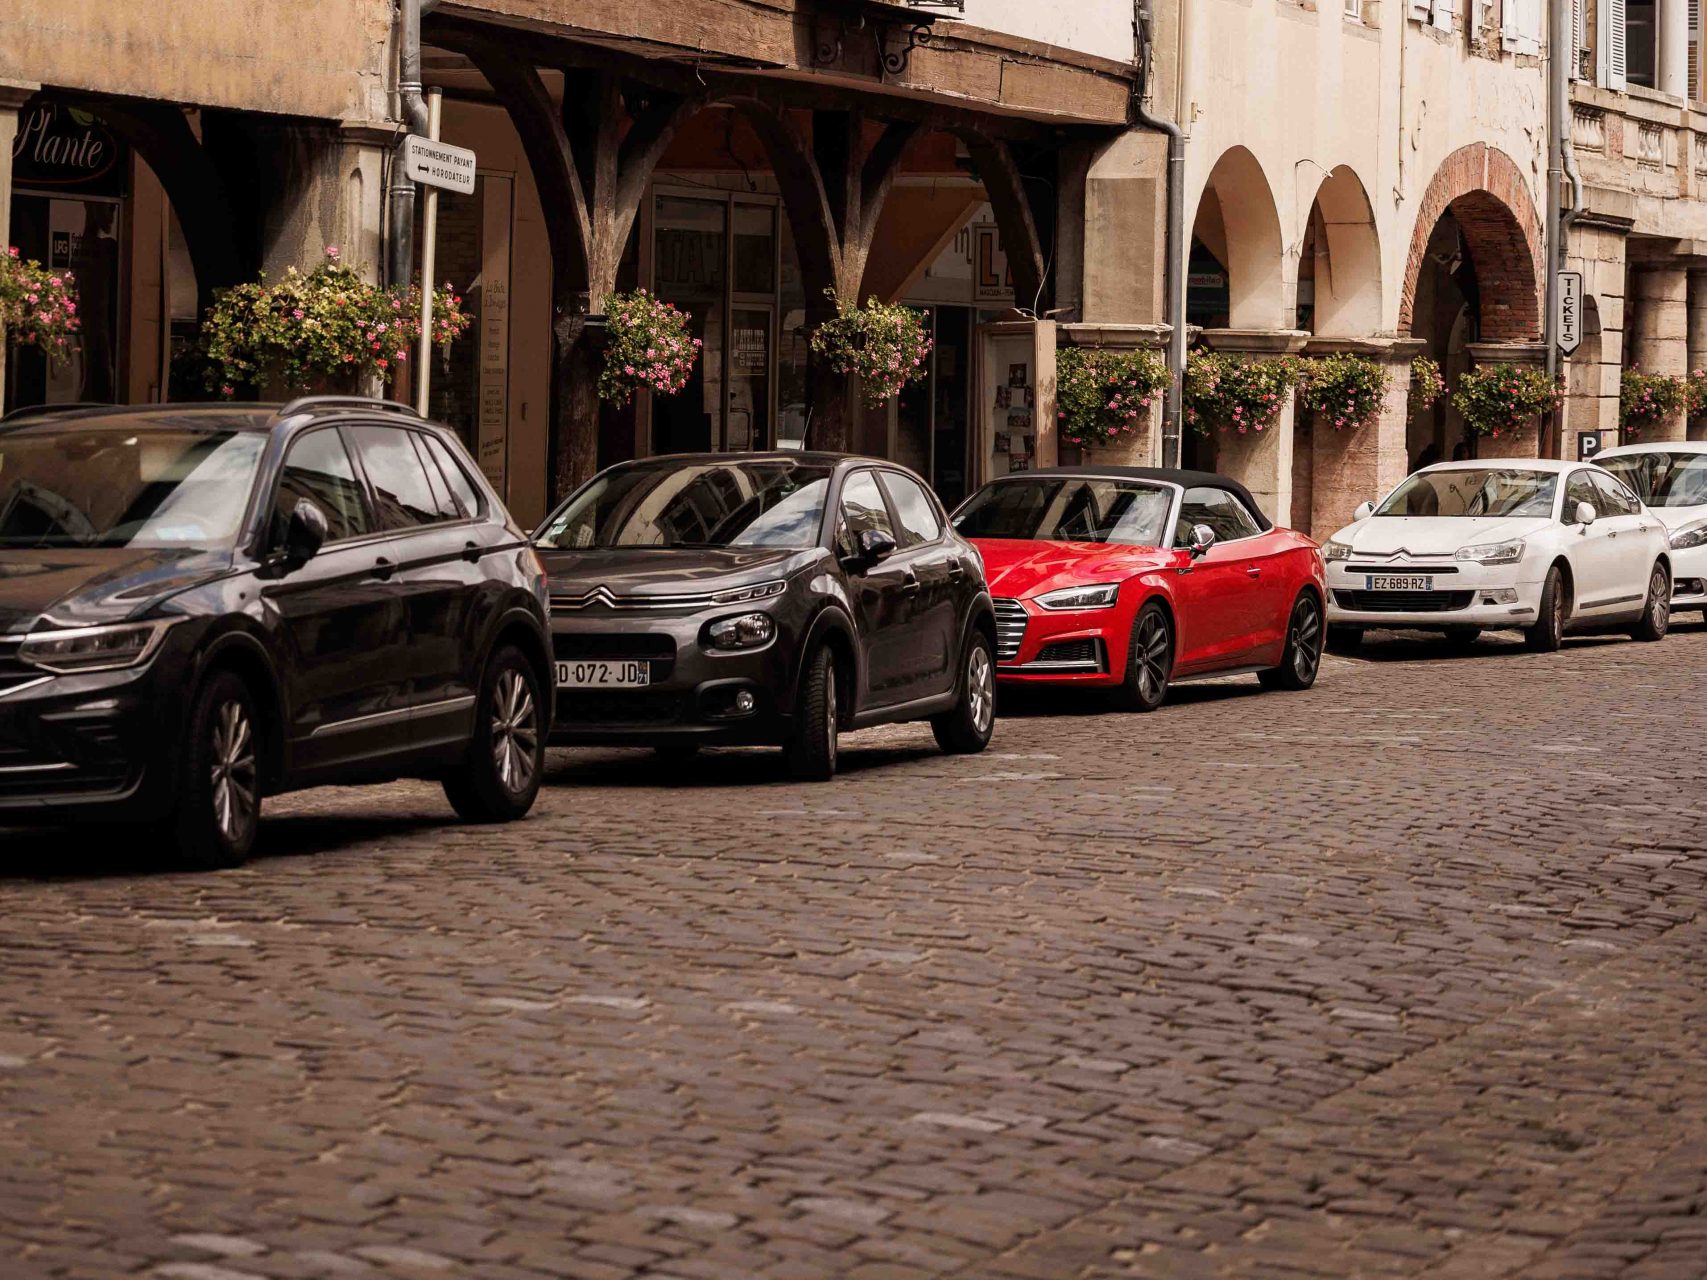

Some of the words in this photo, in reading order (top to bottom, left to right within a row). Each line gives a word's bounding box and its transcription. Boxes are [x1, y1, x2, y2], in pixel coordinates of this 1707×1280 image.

[12, 102, 103, 169] Plante
[412, 145, 453, 164] STATIONNEMENT
[453, 156, 473, 169] PAYANT
[432, 166, 471, 184] HORODATEUR
[1562, 278, 1575, 342] TICKETS
[1583, 437, 1597, 454] P
[1374, 577, 1424, 590] EZ-689-RZ
[638, 673, 647, 683] 71
